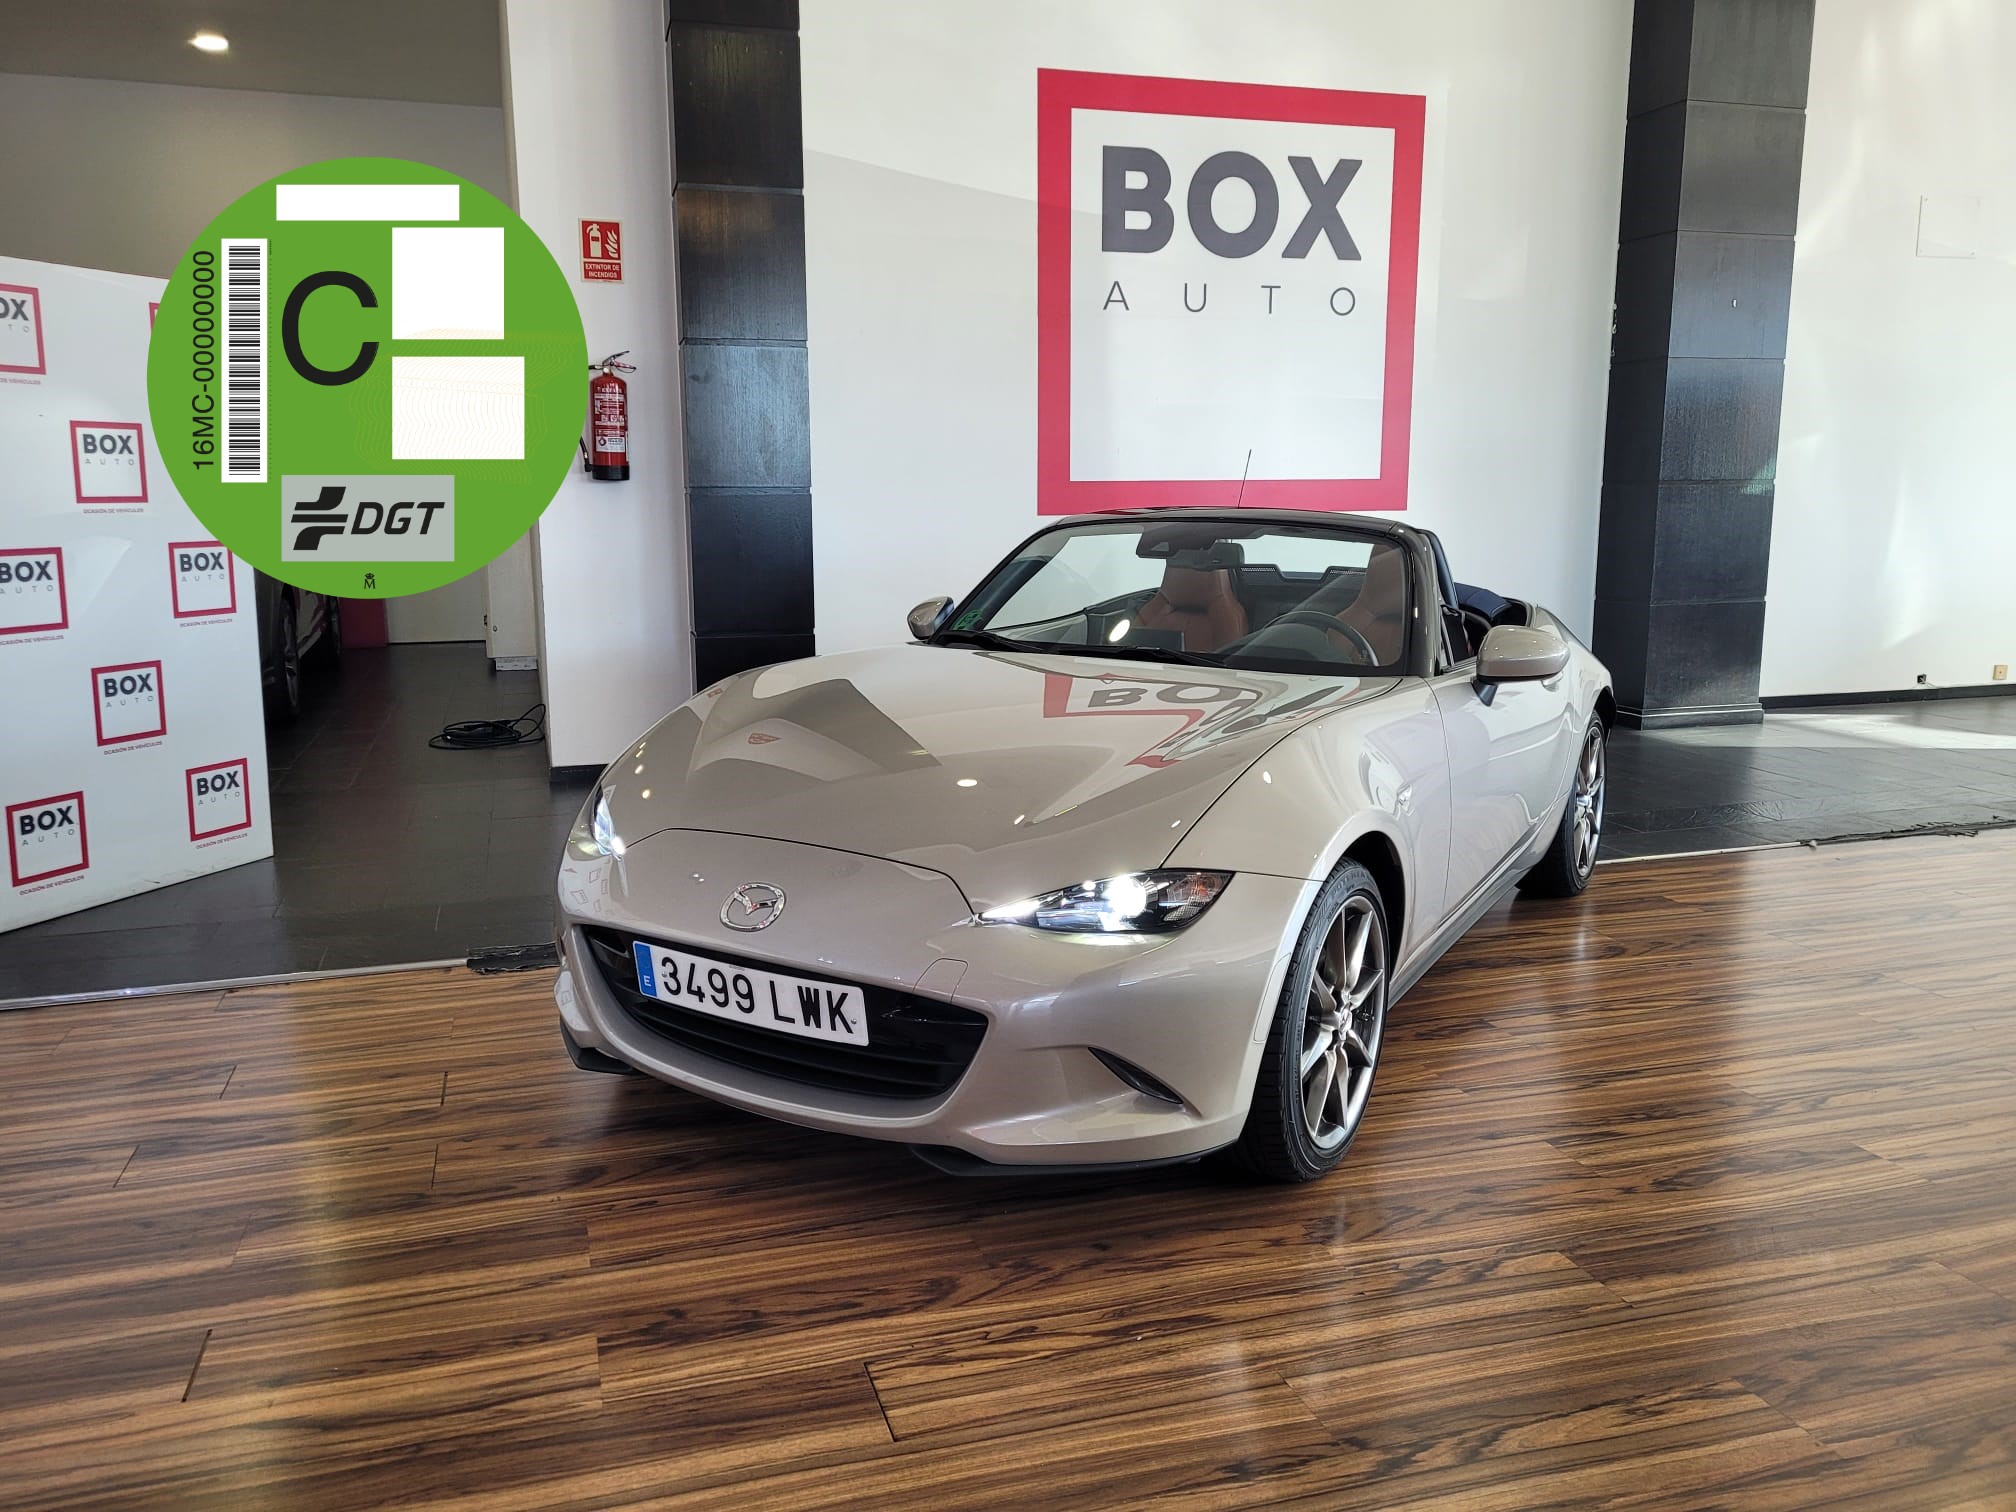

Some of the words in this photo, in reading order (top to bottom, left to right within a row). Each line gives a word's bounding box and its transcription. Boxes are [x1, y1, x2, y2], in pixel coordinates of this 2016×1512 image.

[1102, 145, 1363, 261] BOX
[585, 263, 611, 271] EXTINTOR
[588, 271, 617, 279] INCENDIOS
[1103, 281, 1356, 316] AUTO
[83, 434, 134, 455] BOX
[85, 458, 135, 466] AUTO
[0, 561, 53, 584] BOX
[180, 552, 224, 573] BOX
[181, 573, 225, 582] AUTO
[104, 673, 153, 698] BOX
[106, 695, 154, 708] AUTO
[197, 771, 240, 796] BOX
[199, 791, 240, 805] AUTO
[20, 805, 74, 836] BOX
[22, 828, 75, 846] AUTO
[644, 976, 651, 987] E
[661, 956, 755, 1014] 3499
[770, 980, 854, 1034] LWK
